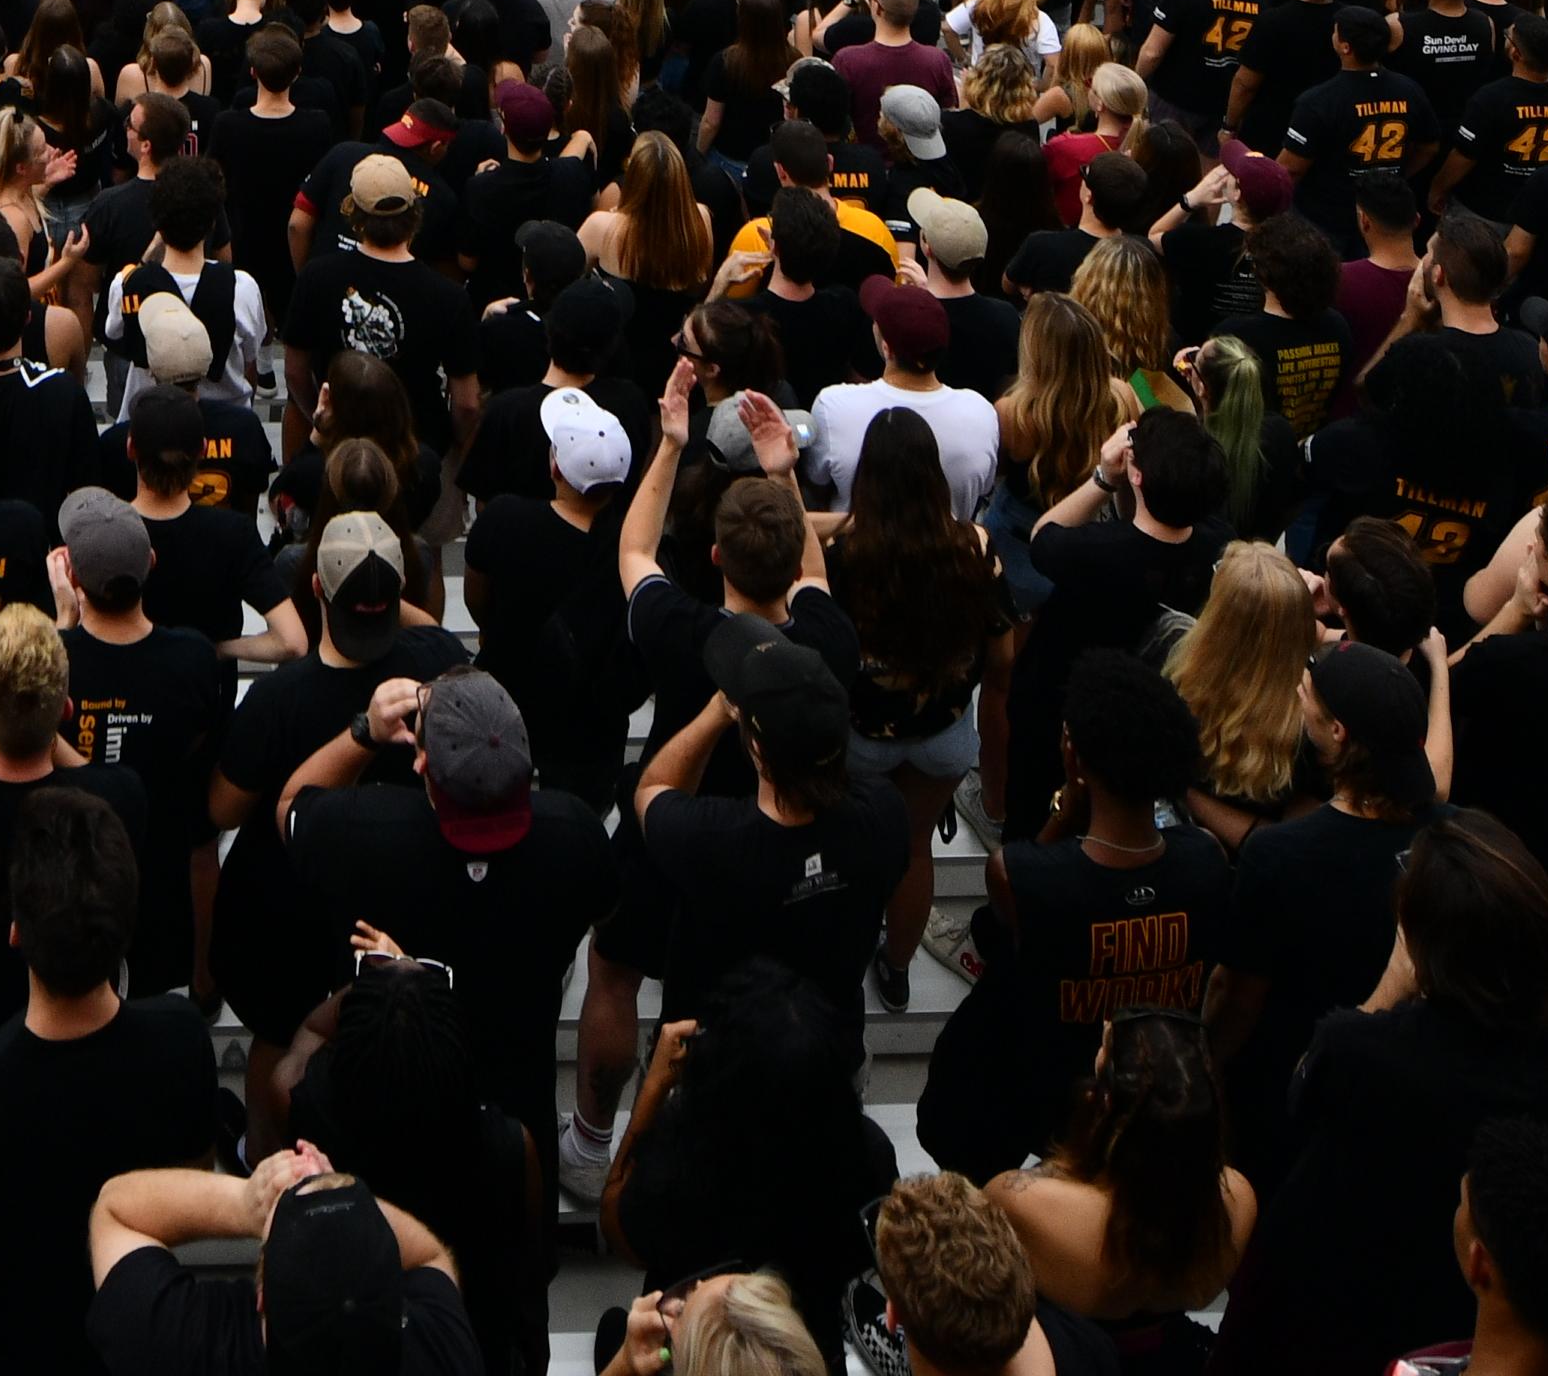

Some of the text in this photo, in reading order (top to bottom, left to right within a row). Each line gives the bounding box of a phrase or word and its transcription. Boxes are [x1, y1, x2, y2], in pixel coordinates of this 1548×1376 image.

[1205, 16, 1254, 54] 42
[1424, 35, 1467, 45] Sun Devil
[1423, 43, 1480, 55] GIVING DAY
[1355, 101, 1408, 117] TILLMAN
[1349, 120, 1408, 164] 42
[1314, 341, 1340, 355] MAKES
[1396, 477, 1489, 518] TILLMAN
[81, 698, 126, 711] Bound by
[107, 713, 153, 725] Driven by
[1089, 912, 1189, 976] FIND
[1059, 961, 1205, 1024] WORK!
